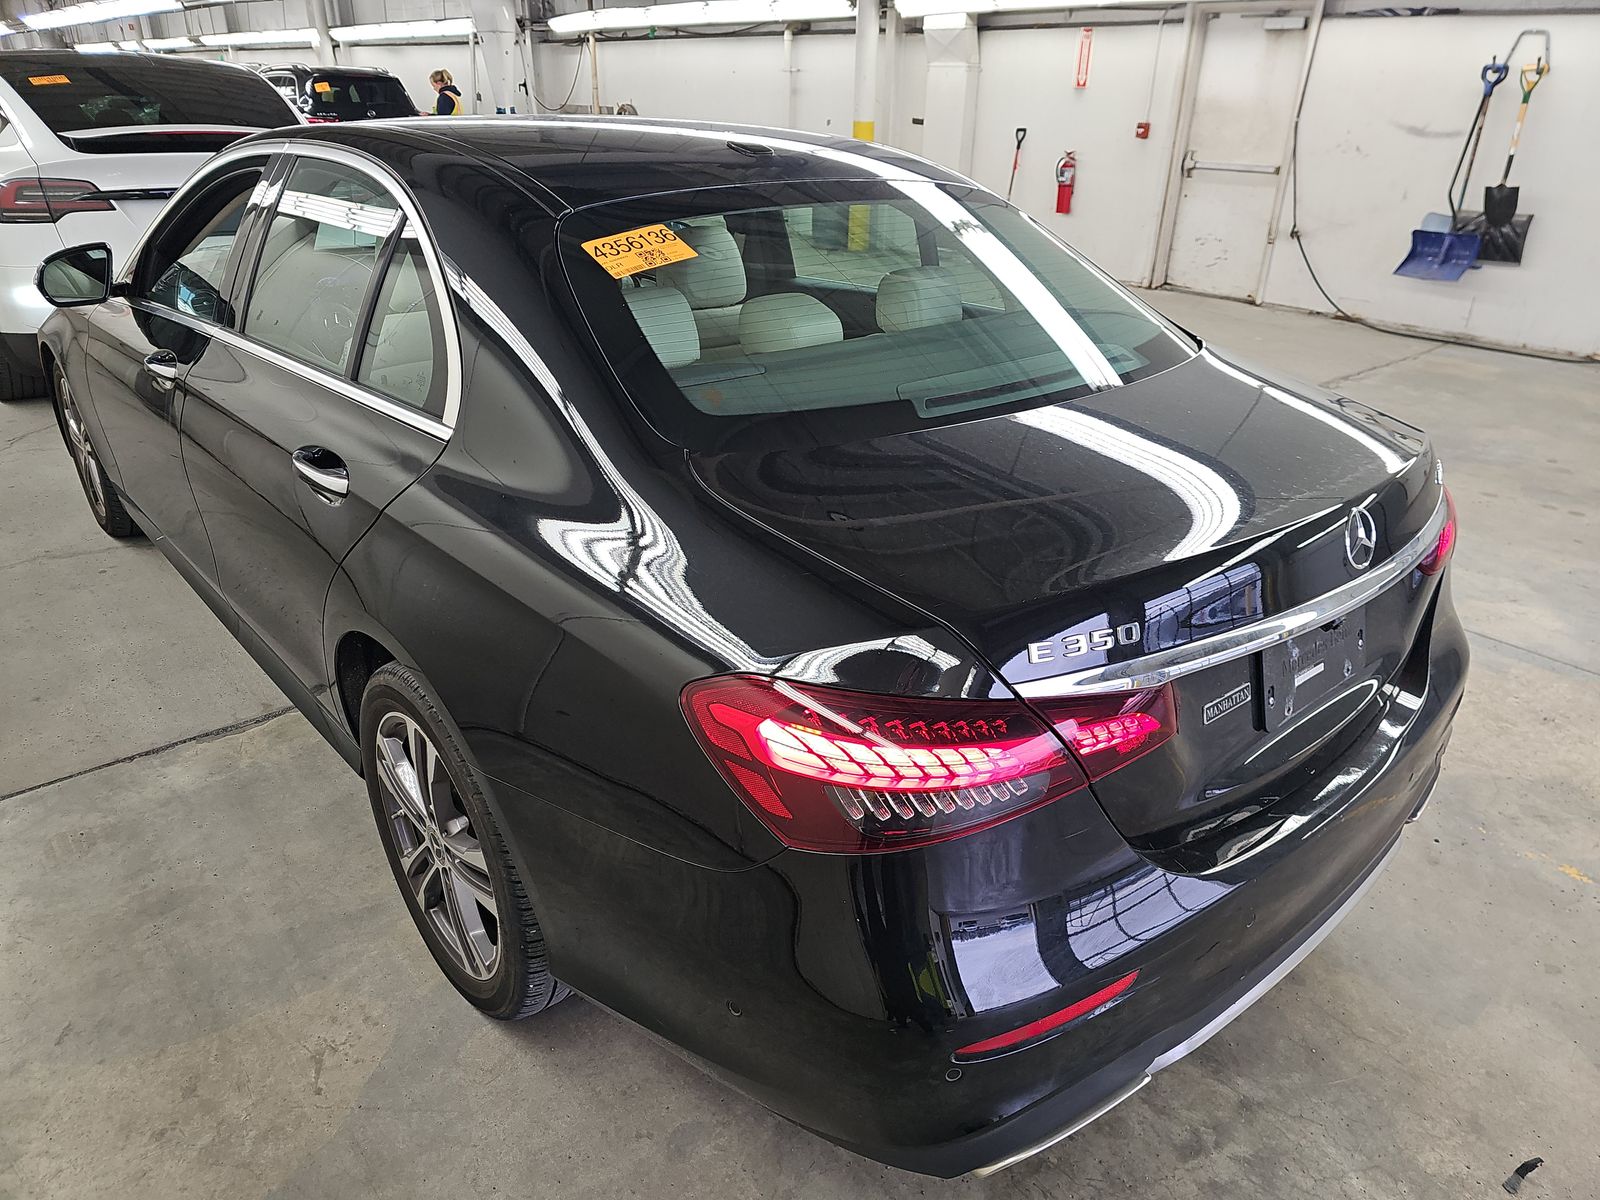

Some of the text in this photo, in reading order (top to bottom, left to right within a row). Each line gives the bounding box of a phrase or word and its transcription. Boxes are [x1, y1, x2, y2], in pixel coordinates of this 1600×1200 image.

[594, 228, 677, 259] 4356136
[1028, 622, 1141, 664] E 350
[1206, 686, 1250, 720] MANHATTAN
